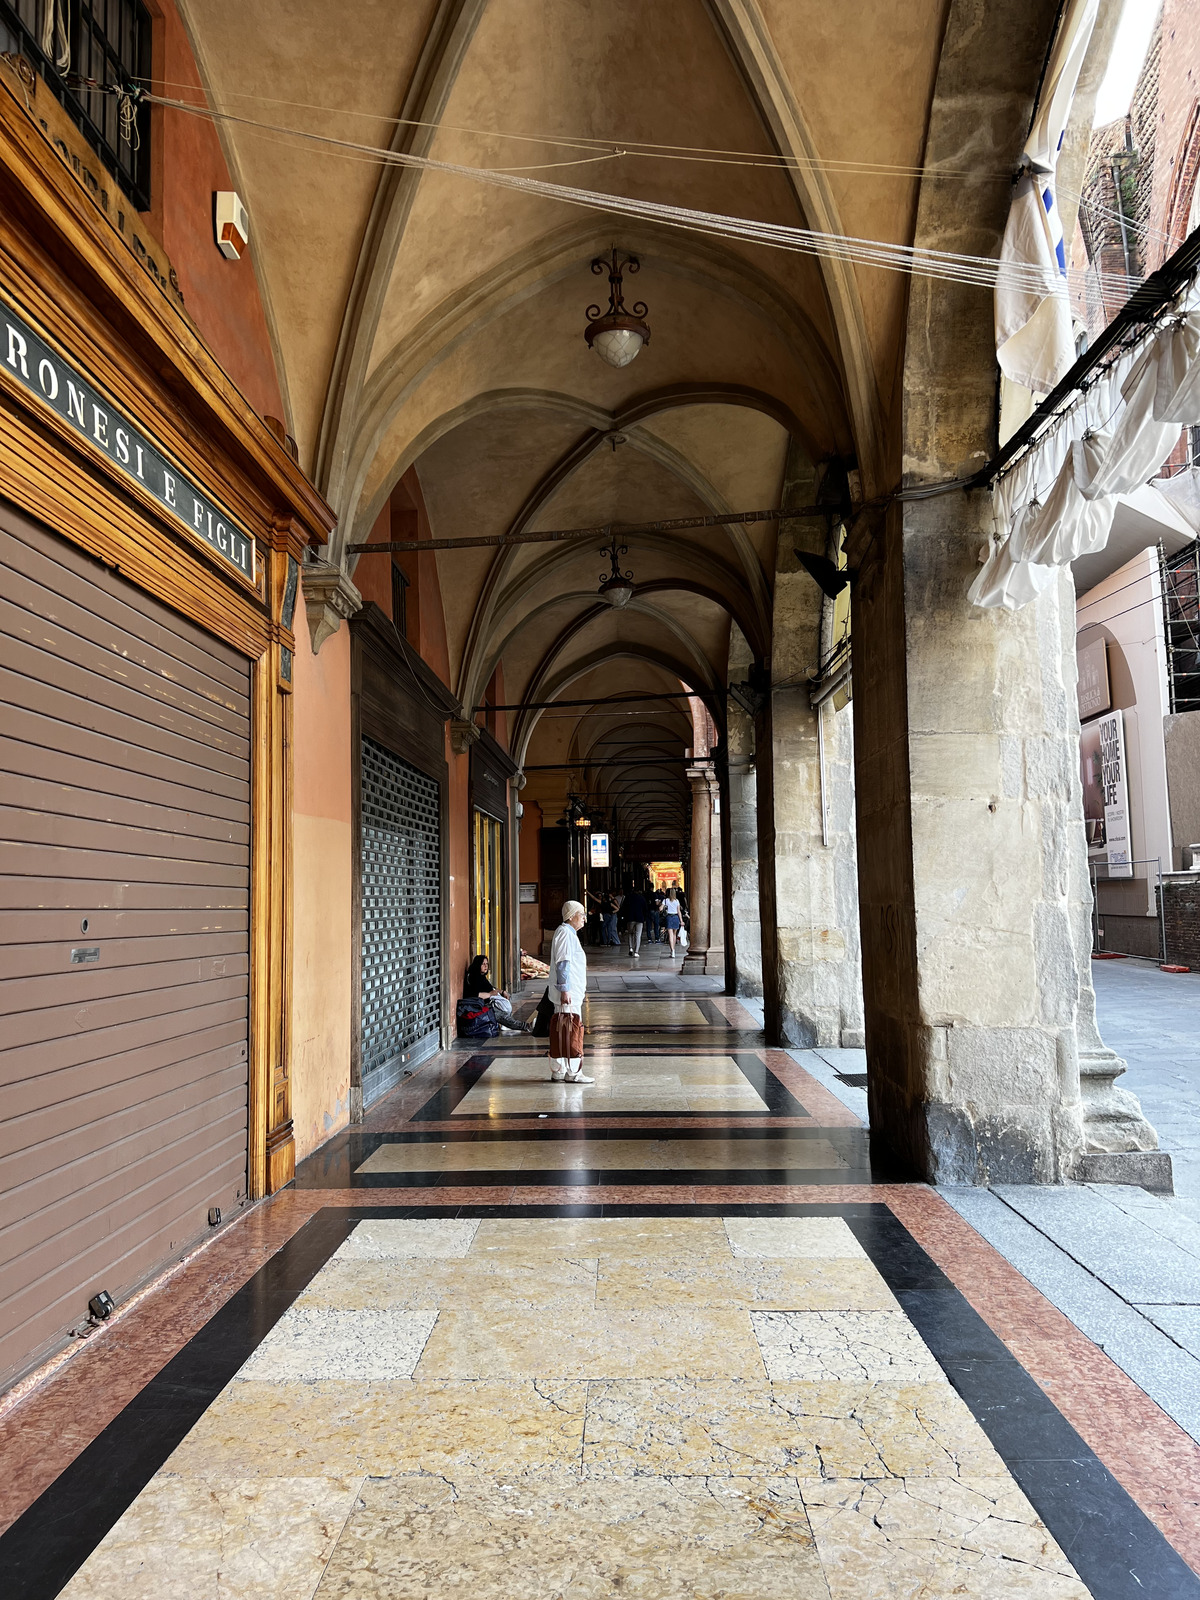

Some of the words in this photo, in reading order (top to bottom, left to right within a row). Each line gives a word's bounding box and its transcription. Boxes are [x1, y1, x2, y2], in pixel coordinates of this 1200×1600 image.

[163, 470, 176, 507] E
[193, 498, 247, 570] FIGLI
[1099, 718, 1117, 741] YOUR
[1101, 740, 1120, 763] HOME
[1102, 761, 1120, 784] YOUR
[1103, 784, 1117, 806] LIFE
